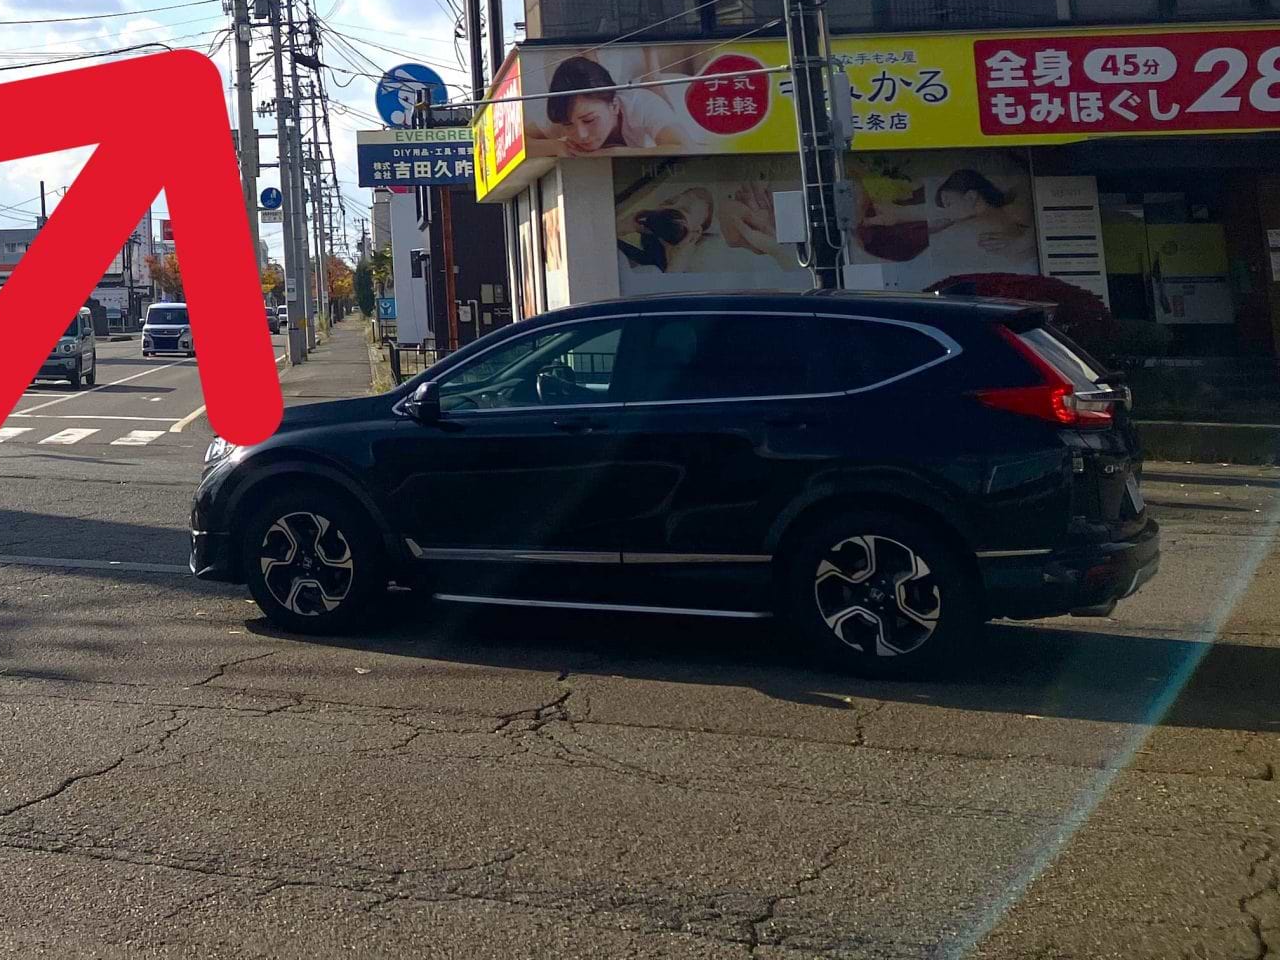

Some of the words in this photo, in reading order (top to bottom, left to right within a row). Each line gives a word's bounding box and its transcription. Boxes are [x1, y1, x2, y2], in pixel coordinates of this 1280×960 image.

[985, 48, 1072, 88] 全身
[1101, 53, 1160, 76] 45分
[991, 89, 1181, 125] もみほぐし
[374, 171, 392, 180] 会社
